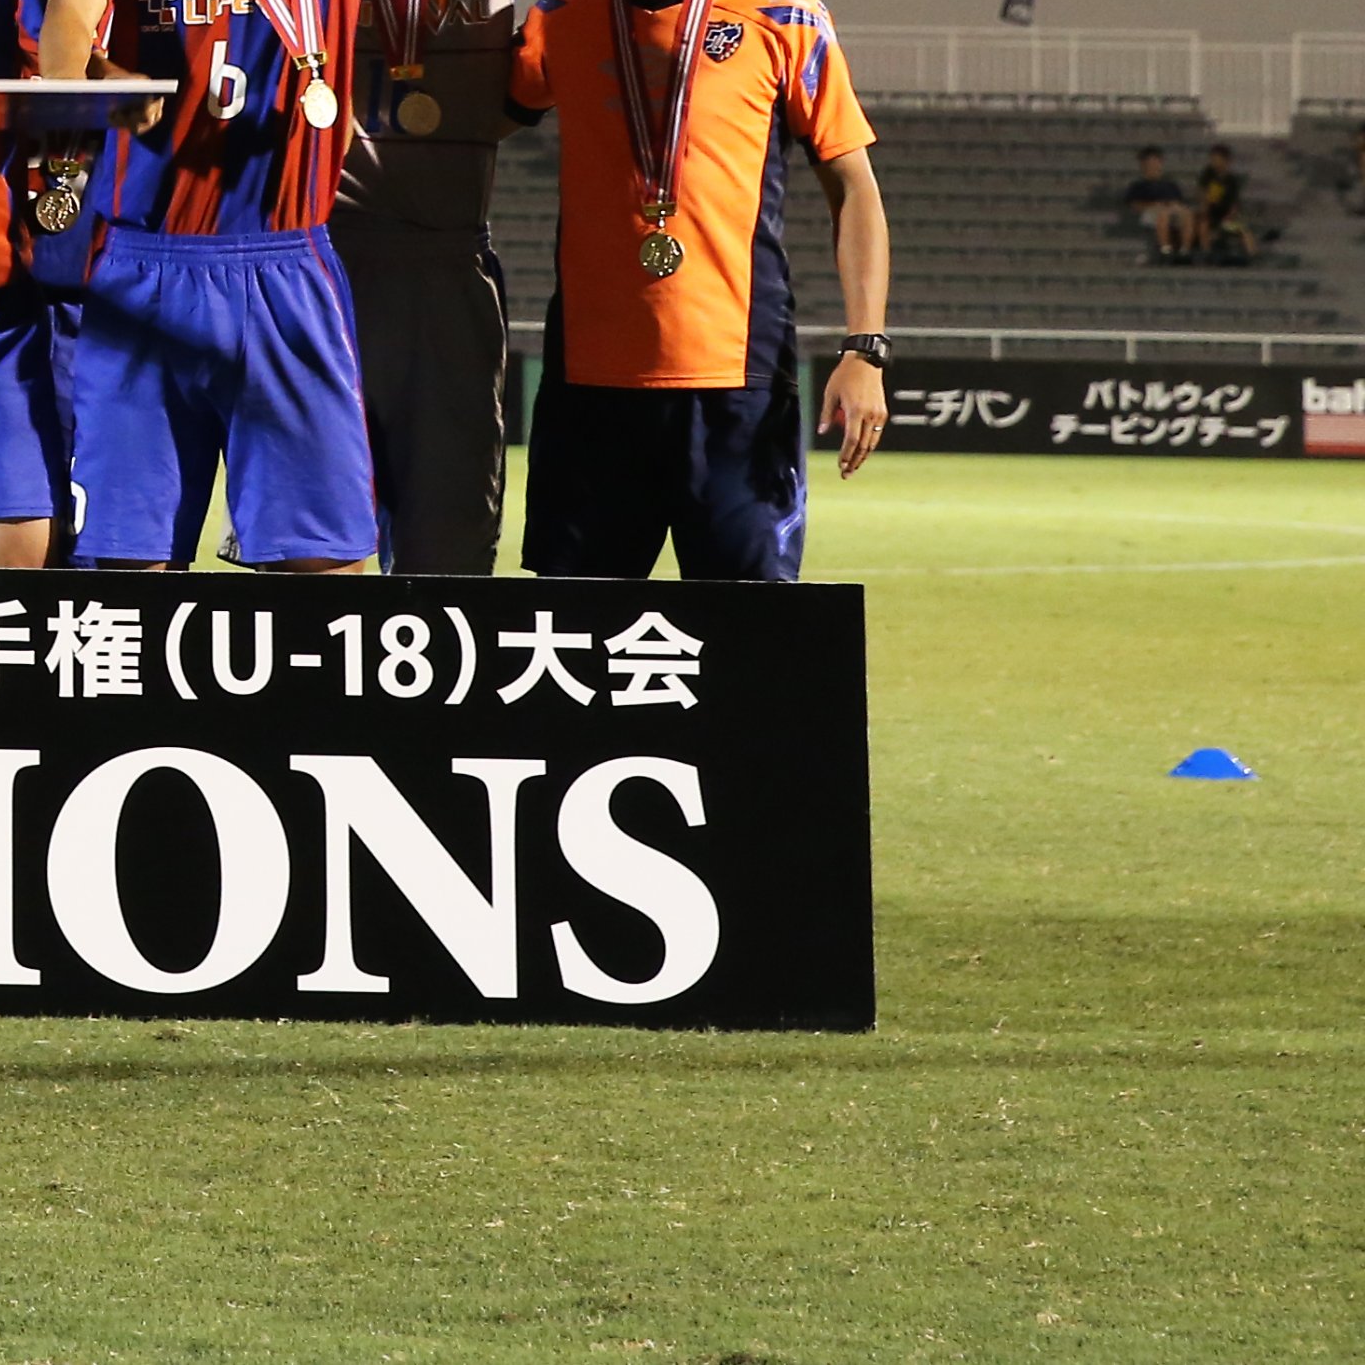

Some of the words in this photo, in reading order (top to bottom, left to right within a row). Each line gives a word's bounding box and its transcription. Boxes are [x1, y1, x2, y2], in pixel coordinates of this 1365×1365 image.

[207, 40, 247, 120] 6
[890, 388, 1031, 428] ニチバン
[1083, 379, 1255, 414] バトルウィン
[1050, 414, 1291, 447] テーピングテープ
